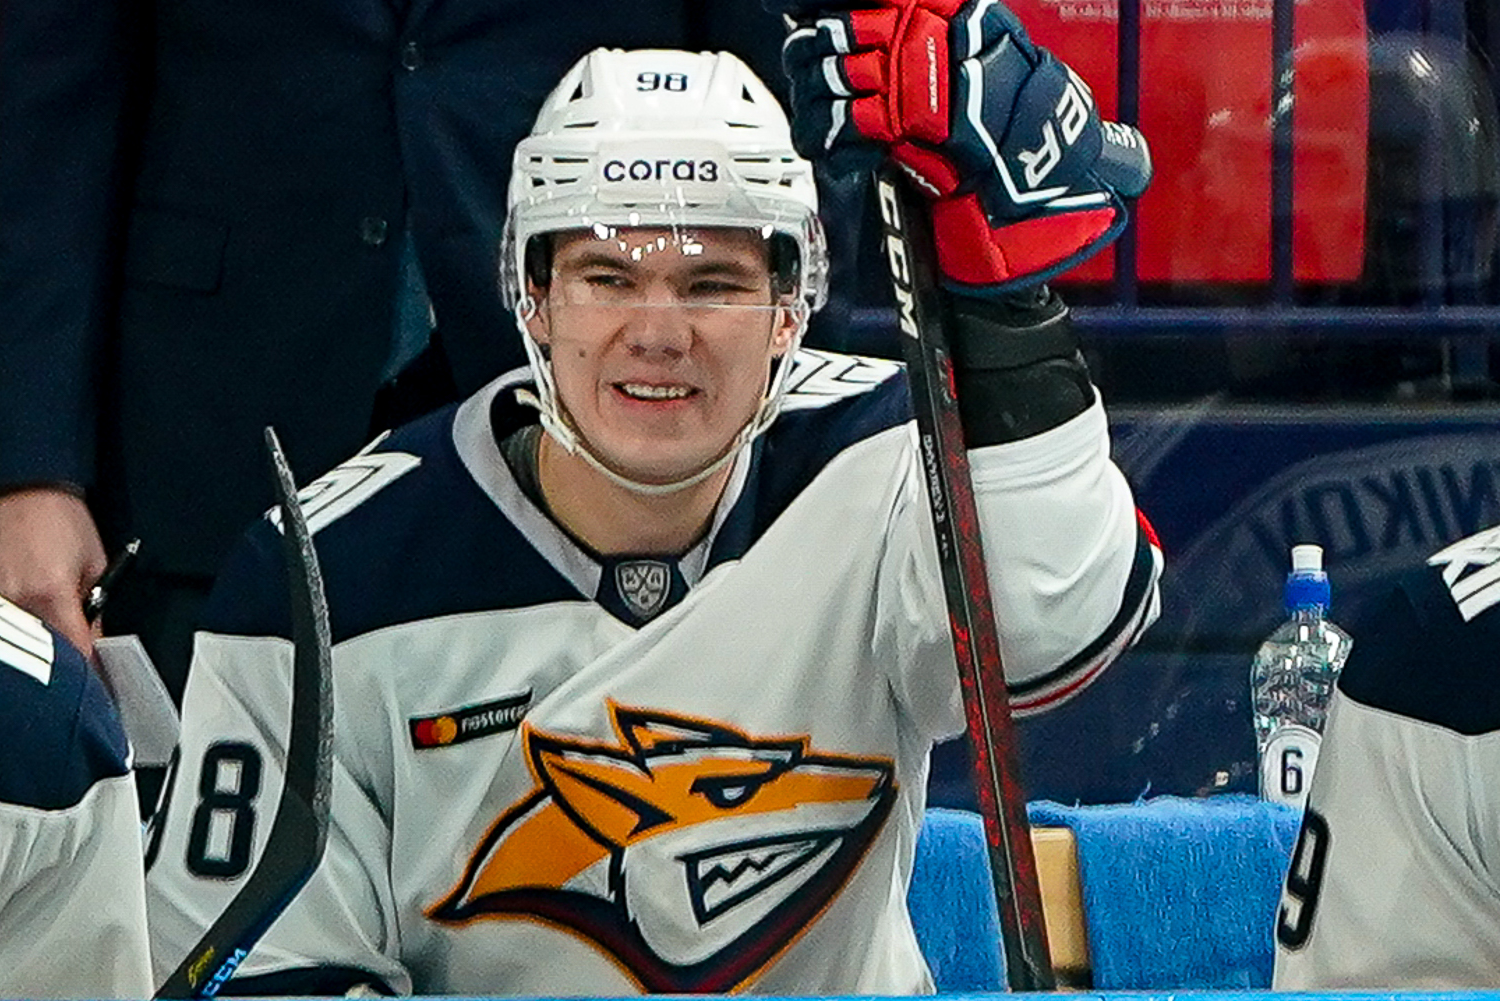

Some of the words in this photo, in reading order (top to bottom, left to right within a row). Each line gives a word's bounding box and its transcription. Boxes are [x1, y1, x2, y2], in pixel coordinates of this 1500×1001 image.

[635, 71, 690, 93] 98
[602, 159, 720, 183] согаз
[878, 178, 920, 341] CCM
[1280, 748, 1304, 796] 6
[201, 947, 247, 997] CCM
